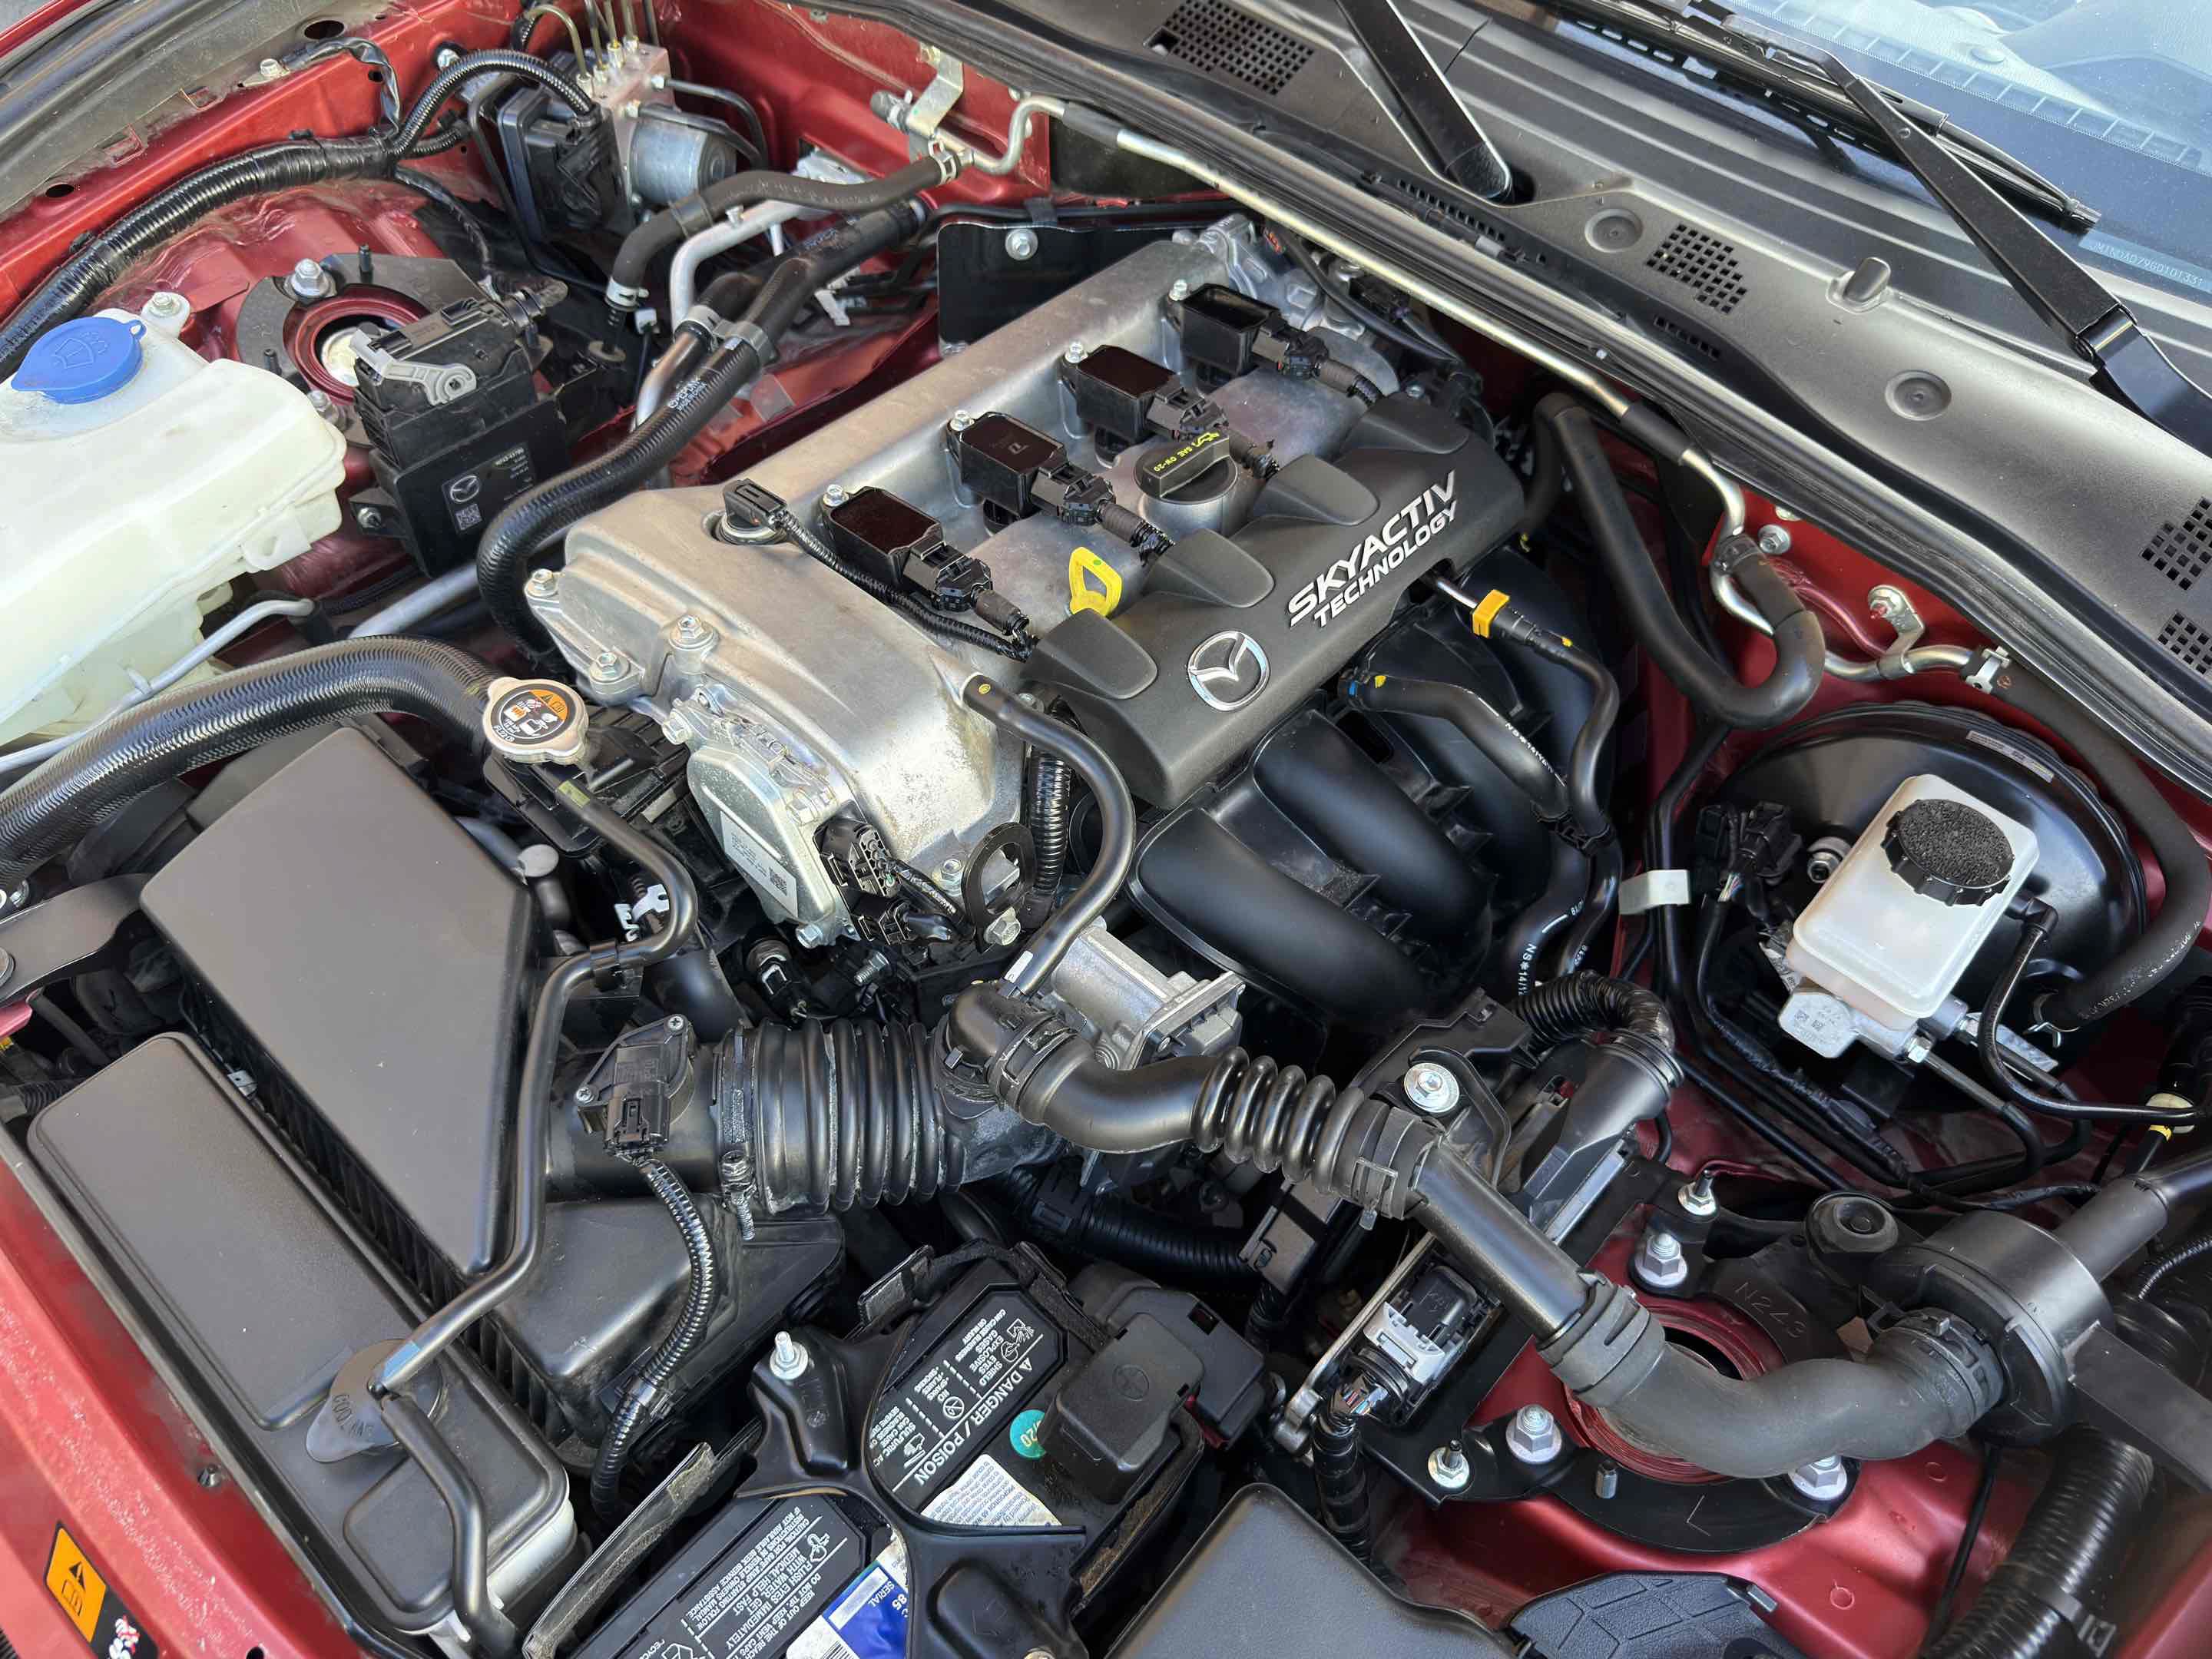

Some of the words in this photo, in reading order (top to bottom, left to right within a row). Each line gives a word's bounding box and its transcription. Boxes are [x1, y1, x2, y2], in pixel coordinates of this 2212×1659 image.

[1177, 445, 1193, 457] SAE
[1154, 456, 1177, 472] 0W-20
[1286, 470, 1457, 627] SKYACTIV
[1313, 502, 1459, 628] TECHNOLOGY
[974, 1328, 998, 1354] GASES
[968, 1335, 1005, 1372] EXPLOSIVE
[977, 1354, 997, 1374] EYES
[978, 1360, 1003, 1386] SHIELD
[935, 1388, 949, 1402] NO
[969, 1369, 1025, 1426] DANGER
[896, 1416, 911, 1430] CAN
[879, 1427, 899, 1448] CAUSE
[881, 1421, 916, 1457] SULFURIC
[912, 1431, 965, 1485] POISON
[780, 1511, 795, 1526] NOT
[765, 1511, 804, 1551] INSTRUCTIONS
[771, 1540, 786, 1555] FOR
[737, 1553, 762, 1578] VEHICLE
[767, 1545, 800, 1578] MEDICAL
[784, 1552, 806, 1575] WITH
[786, 1558, 813, 1585] FLUSH
[718, 1562, 743, 1588] SERVICE
[743, 1565, 762, 1583] JUMP
[808, 1571, 821, 1584] DO
[717, 1580, 747, 1609] STARTING
[749, 1575, 771, 1598] HELP
[769, 1581, 791, 1604] EYES
[796, 1588, 815, 1607] KEEP
[797, 1581, 812, 1596] NOT
[867, 1580, 895, 1608] SERIAL
[730, 1594, 753, 1616] FAST
[744, 1595, 764, 1615] GET
[770, 1606, 787, 1624] KEEP
[784, 1604, 800, 1620] OUT
[724, 1600, 773, 1650] IMMEDIATELY
[754, 1621, 773, 1640] VENT
[763, 1626, 778, 1641] THE
[775, 1617, 787, 1629] OF
